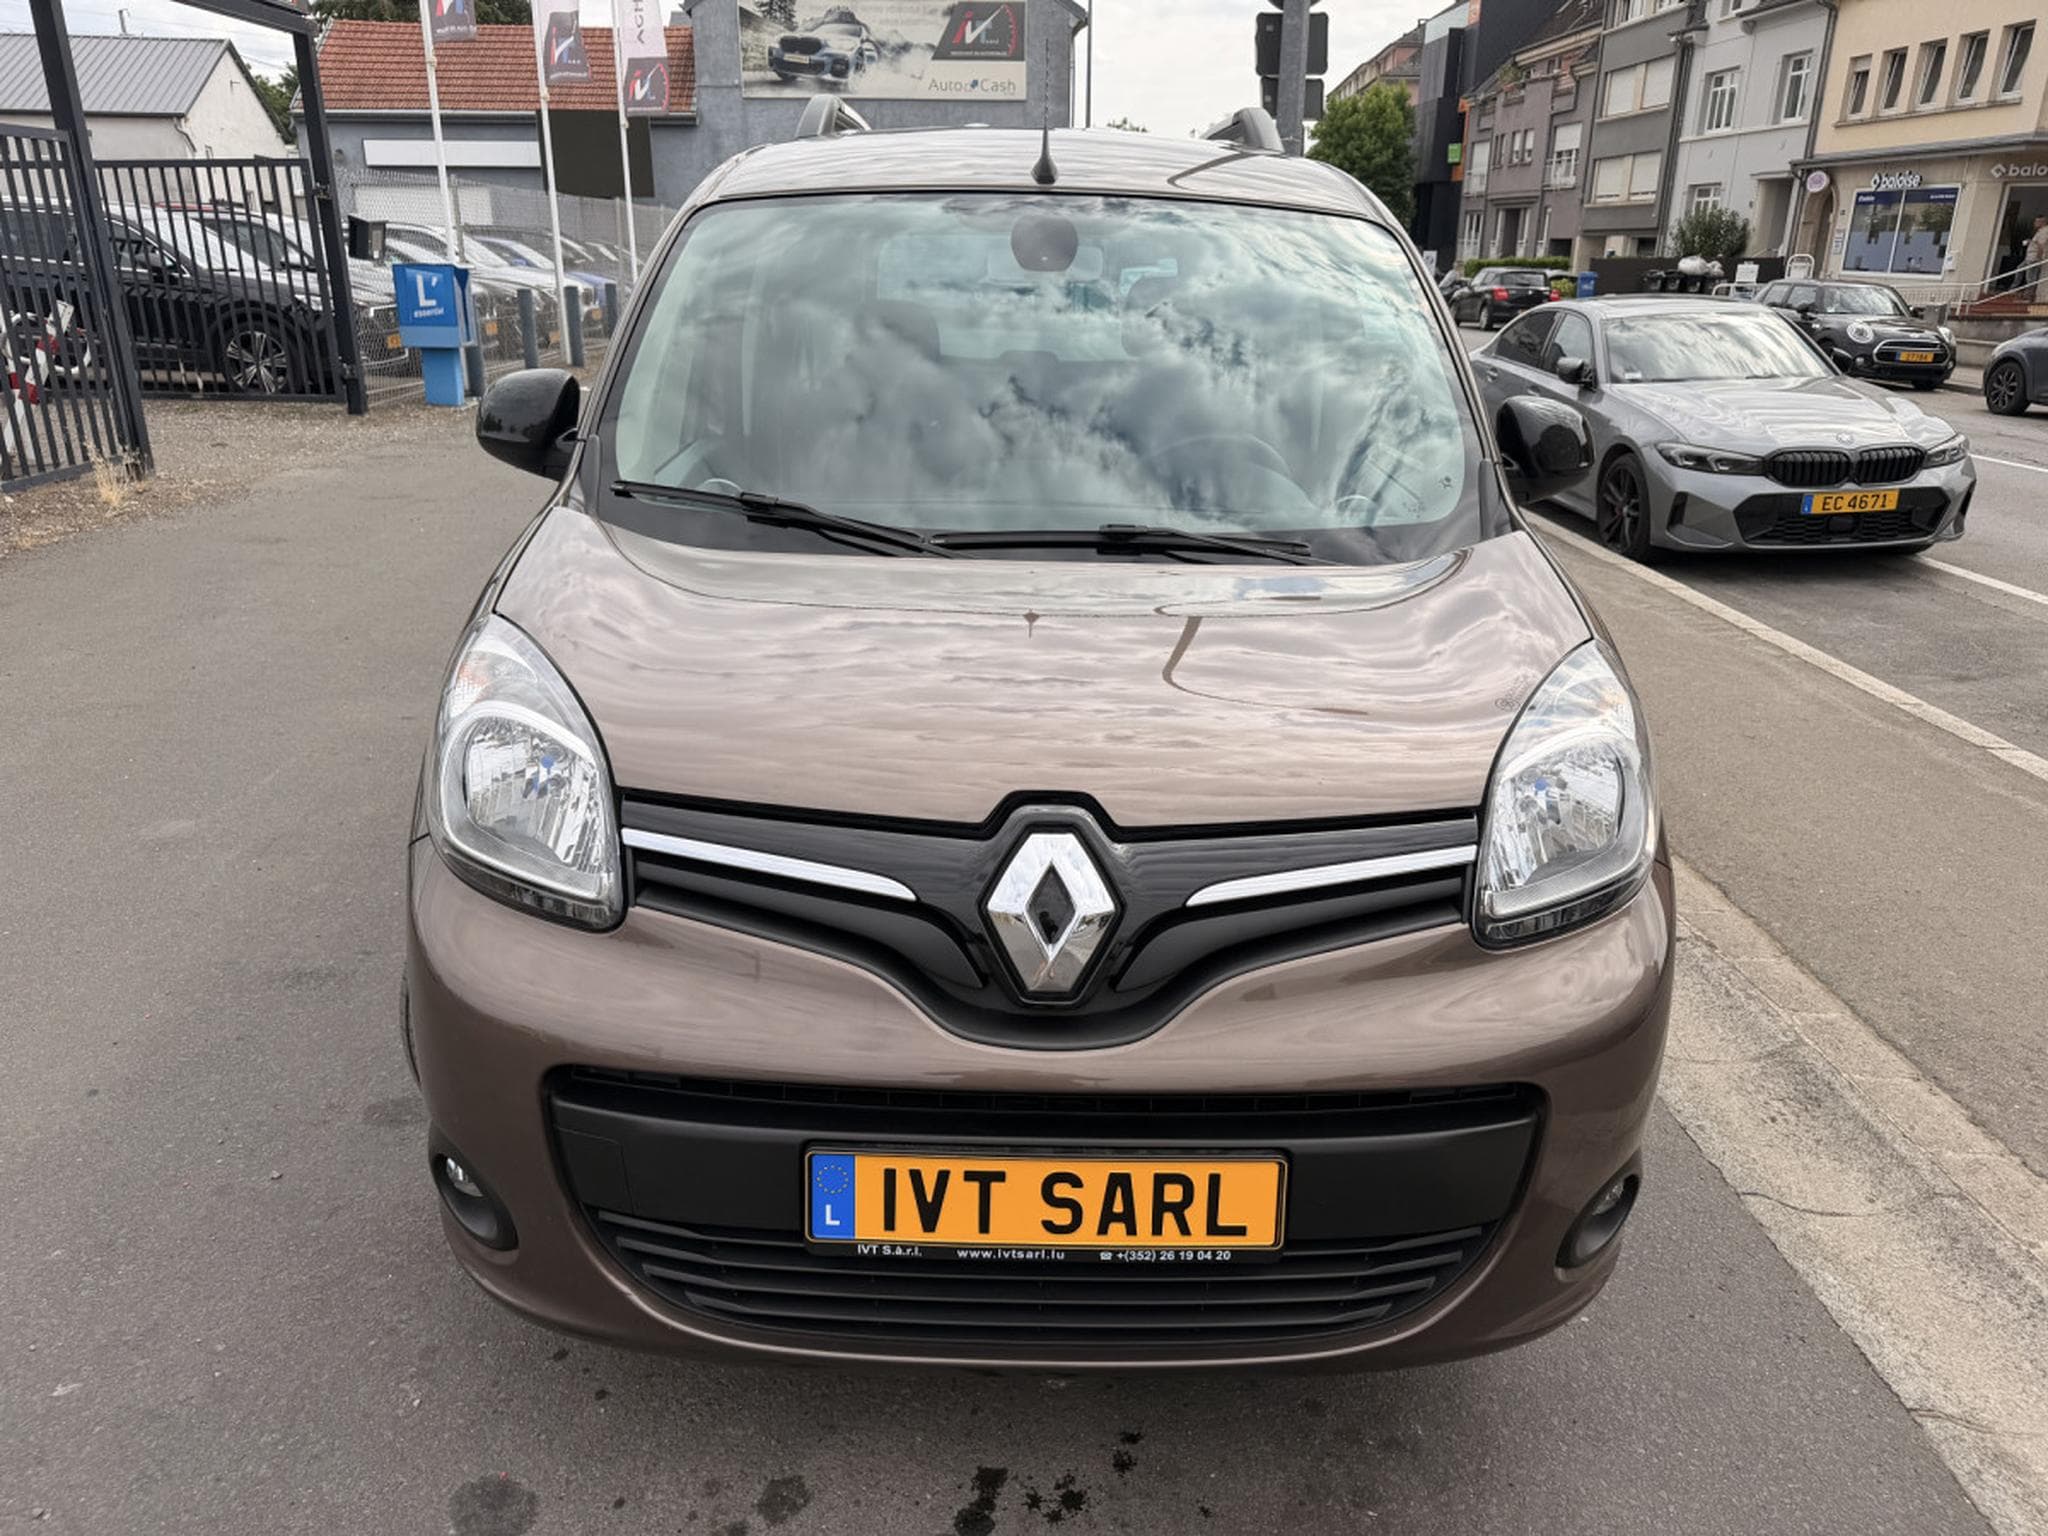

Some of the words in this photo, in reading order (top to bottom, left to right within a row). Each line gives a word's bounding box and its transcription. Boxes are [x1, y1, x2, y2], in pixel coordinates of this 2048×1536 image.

[928, 79, 963, 92] Auto
[980, 78, 1016, 93] Cash
[1881, 170, 1921, 189] baloise
[1822, 496, 1844, 511] EC
[1848, 494, 1888, 510] 4671
[884, 1168, 1006, 1234] IVT
[1041, 1171, 1247, 1236] SARL
[825, 1204, 840, 1226] L
[857, 1244, 879, 1255] IVT
[956, 1248, 1065, 1260] www.ivtsarl.lu
[1116, 1250, 1157, 1262] +(352)
[1160, 1250, 1175, 1261] 26
[1179, 1250, 1194, 1261] 19
[1197, 1250, 1212, 1261] 04
[1216, 1250, 1231, 1261] 20
